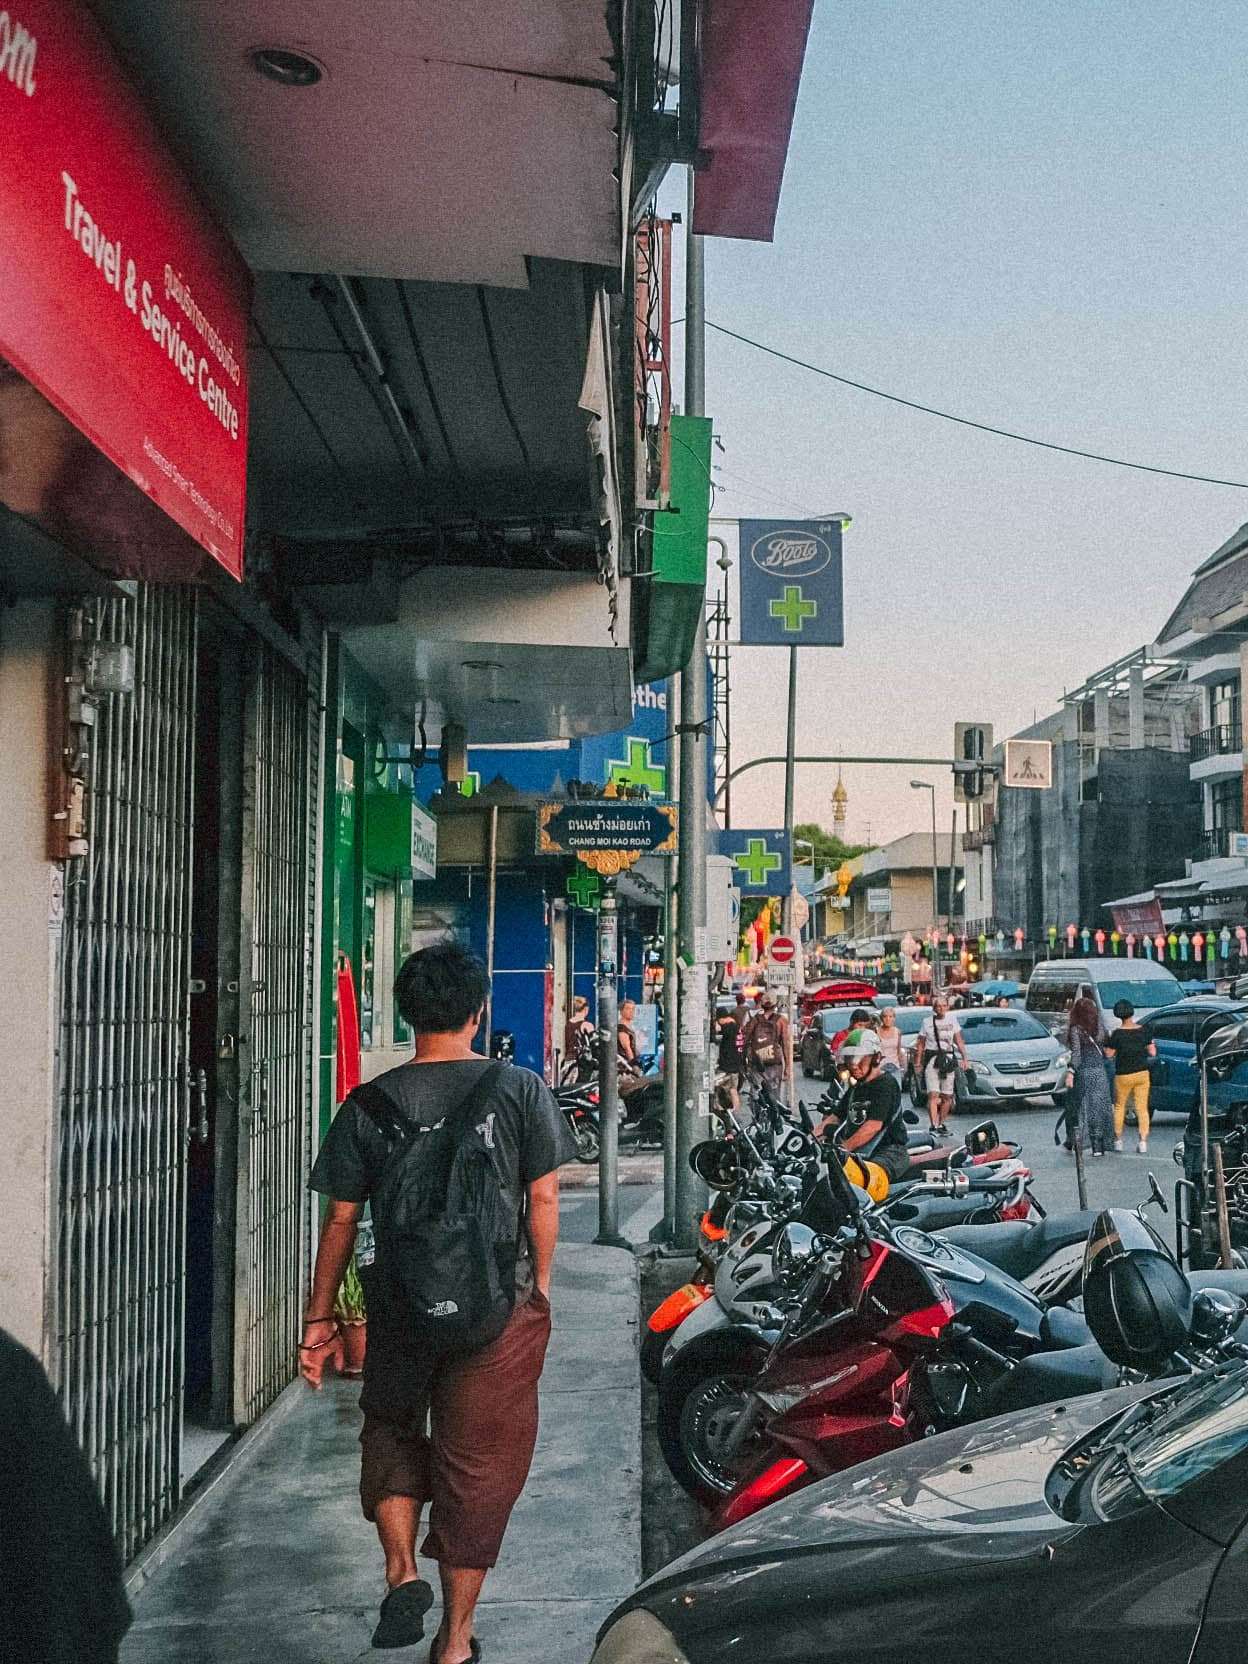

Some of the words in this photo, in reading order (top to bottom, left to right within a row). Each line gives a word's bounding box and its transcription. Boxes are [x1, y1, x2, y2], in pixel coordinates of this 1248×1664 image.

[61, 170, 121, 292] Travel
[124, 258, 137, 315] &
[140, 280, 195, 386] Service
[199, 357, 239, 441] Centre
[761, 538, 818, 568] Boots
[568, 813, 651, 832] ถนนช้างม่อยเก่า
[569, 837, 596, 846] CHANG
[597, 837, 611, 846] MOI
[612, 837, 629, 846] KAO
[630, 837, 652, 846] ROAD
